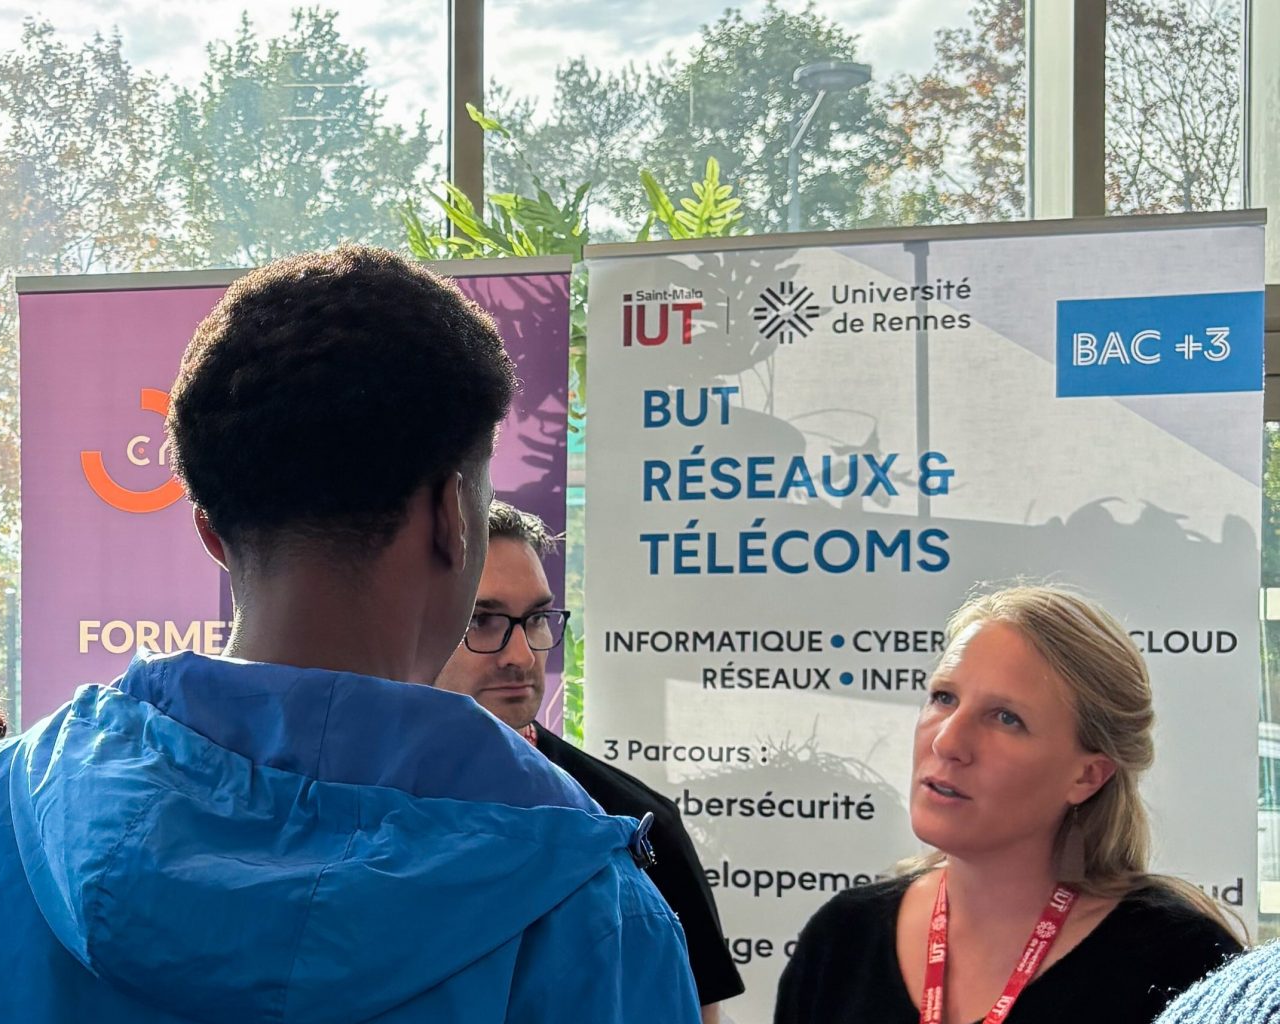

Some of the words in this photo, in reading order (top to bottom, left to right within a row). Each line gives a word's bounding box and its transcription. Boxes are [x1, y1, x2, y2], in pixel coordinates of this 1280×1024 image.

[635, 288, 703, 302] Saint-Malo
[831, 277, 972, 305] Université
[832, 312, 864, 334] de
[873, 311, 972, 333] Rennes
[1072, 329, 1161, 367] BAC
[1175, 326, 1231, 362] +3
[643, 385, 739, 429] BUT
[642, 444, 900, 502] RÉSEAUX
[917, 451, 956, 496] &
[639, 517, 951, 575] TÉLÉCOMS
[604, 630, 823, 653] INFORMATIQUE
[702, 661, 831, 690] RÉSEAUX
[603, 740, 620, 761] 3
[627, 740, 751, 763] Parcours
